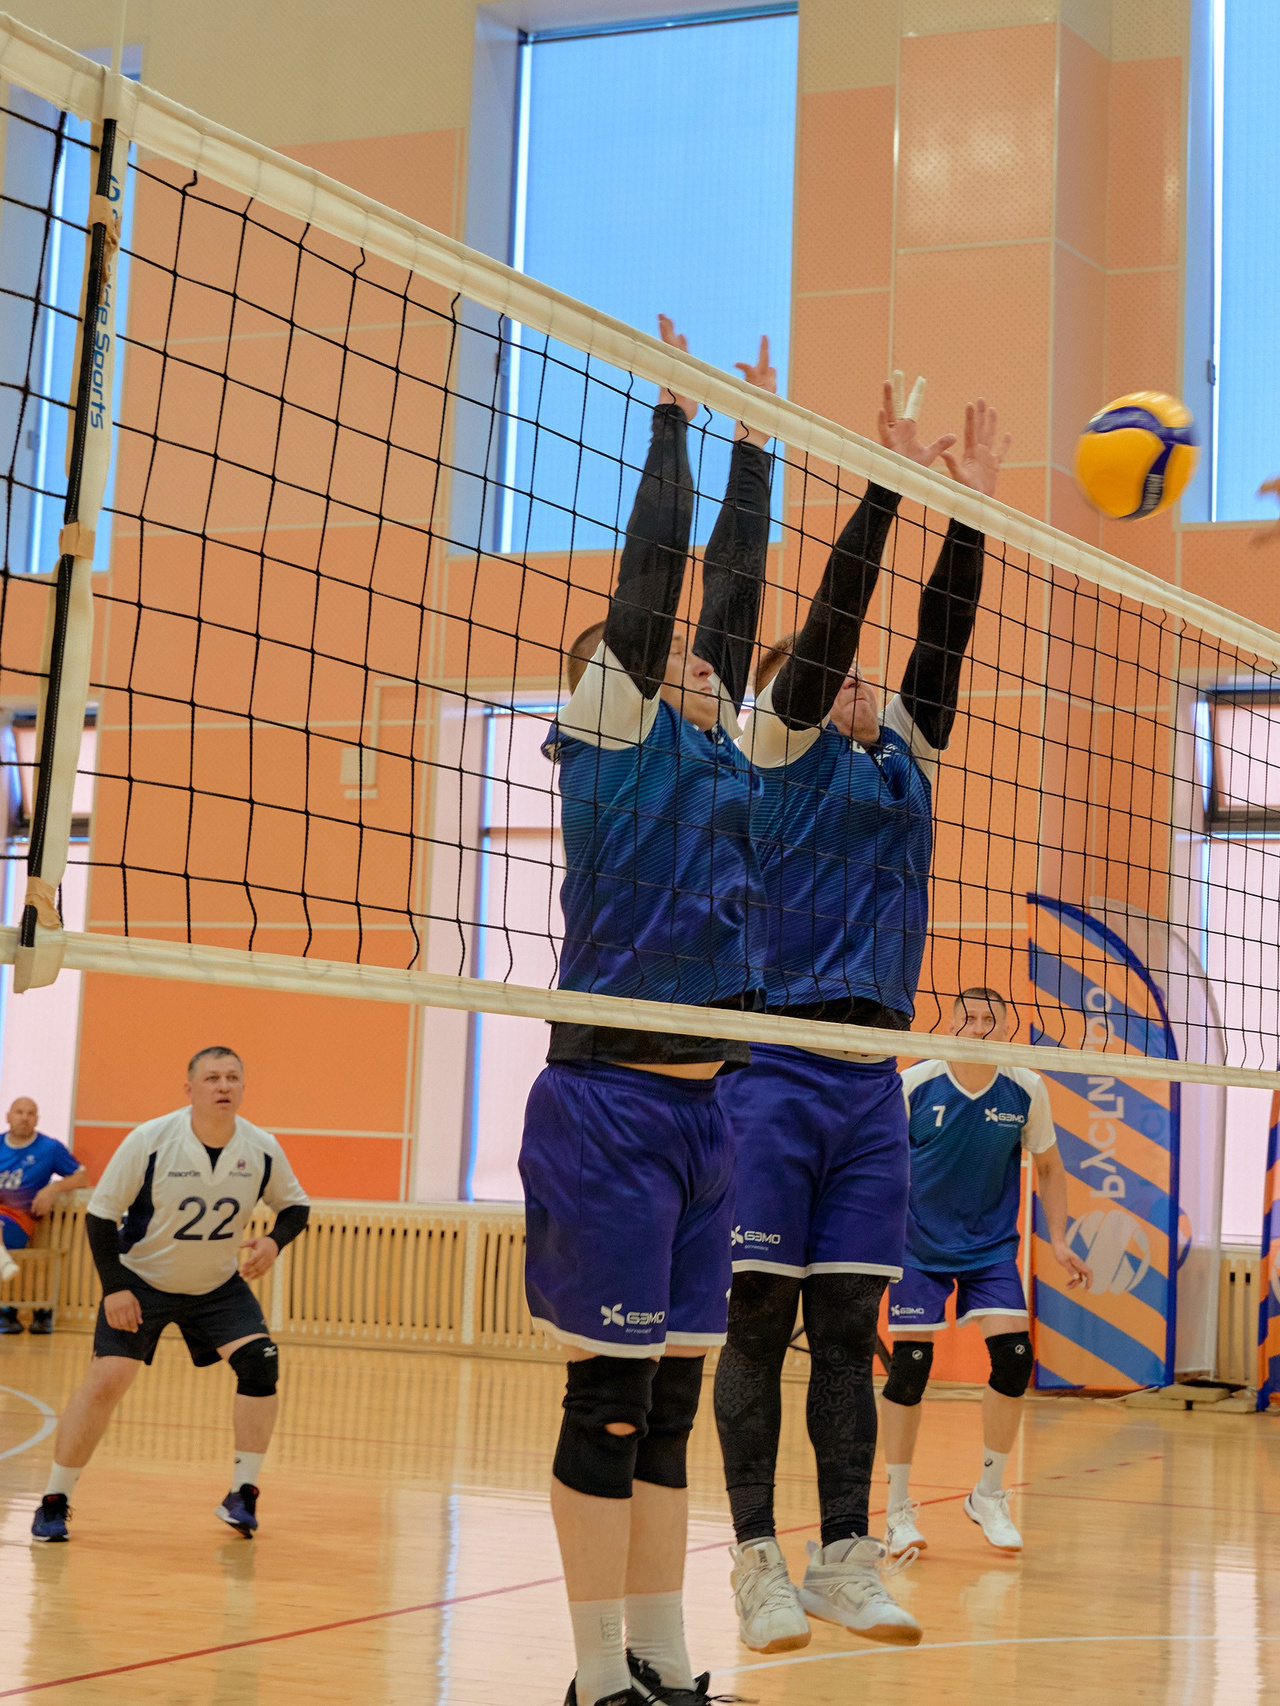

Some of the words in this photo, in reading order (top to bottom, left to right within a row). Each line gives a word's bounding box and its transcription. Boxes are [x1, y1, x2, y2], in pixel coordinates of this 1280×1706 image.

[90, 331, 111, 430] Sports
[932, 1105, 946, 1127] 7
[173, 1196, 240, 1241] 22
